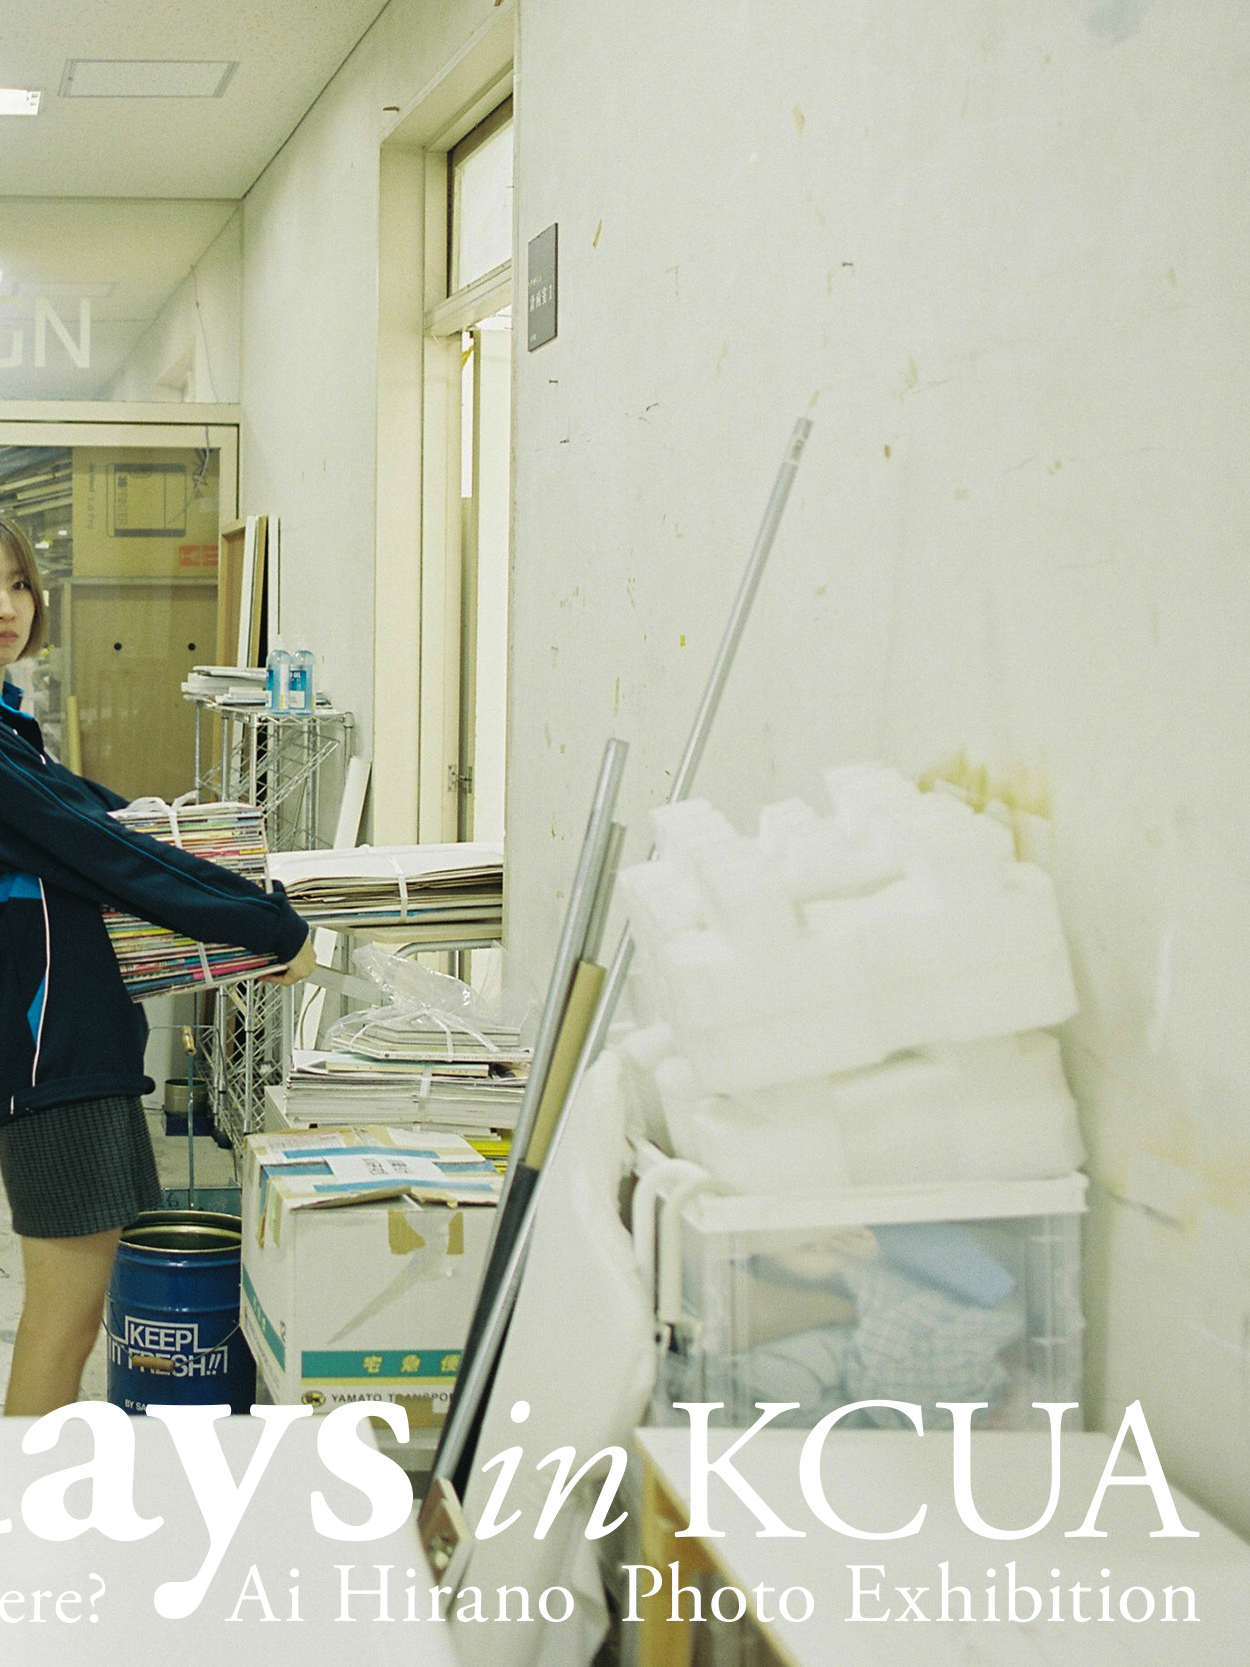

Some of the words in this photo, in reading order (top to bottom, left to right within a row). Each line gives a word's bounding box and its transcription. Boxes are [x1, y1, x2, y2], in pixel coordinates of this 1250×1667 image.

[130, 1323, 193, 1352] KEEP
[331, 1393, 382, 1402] YAMATO
[125, 1399, 134, 1409] BY
